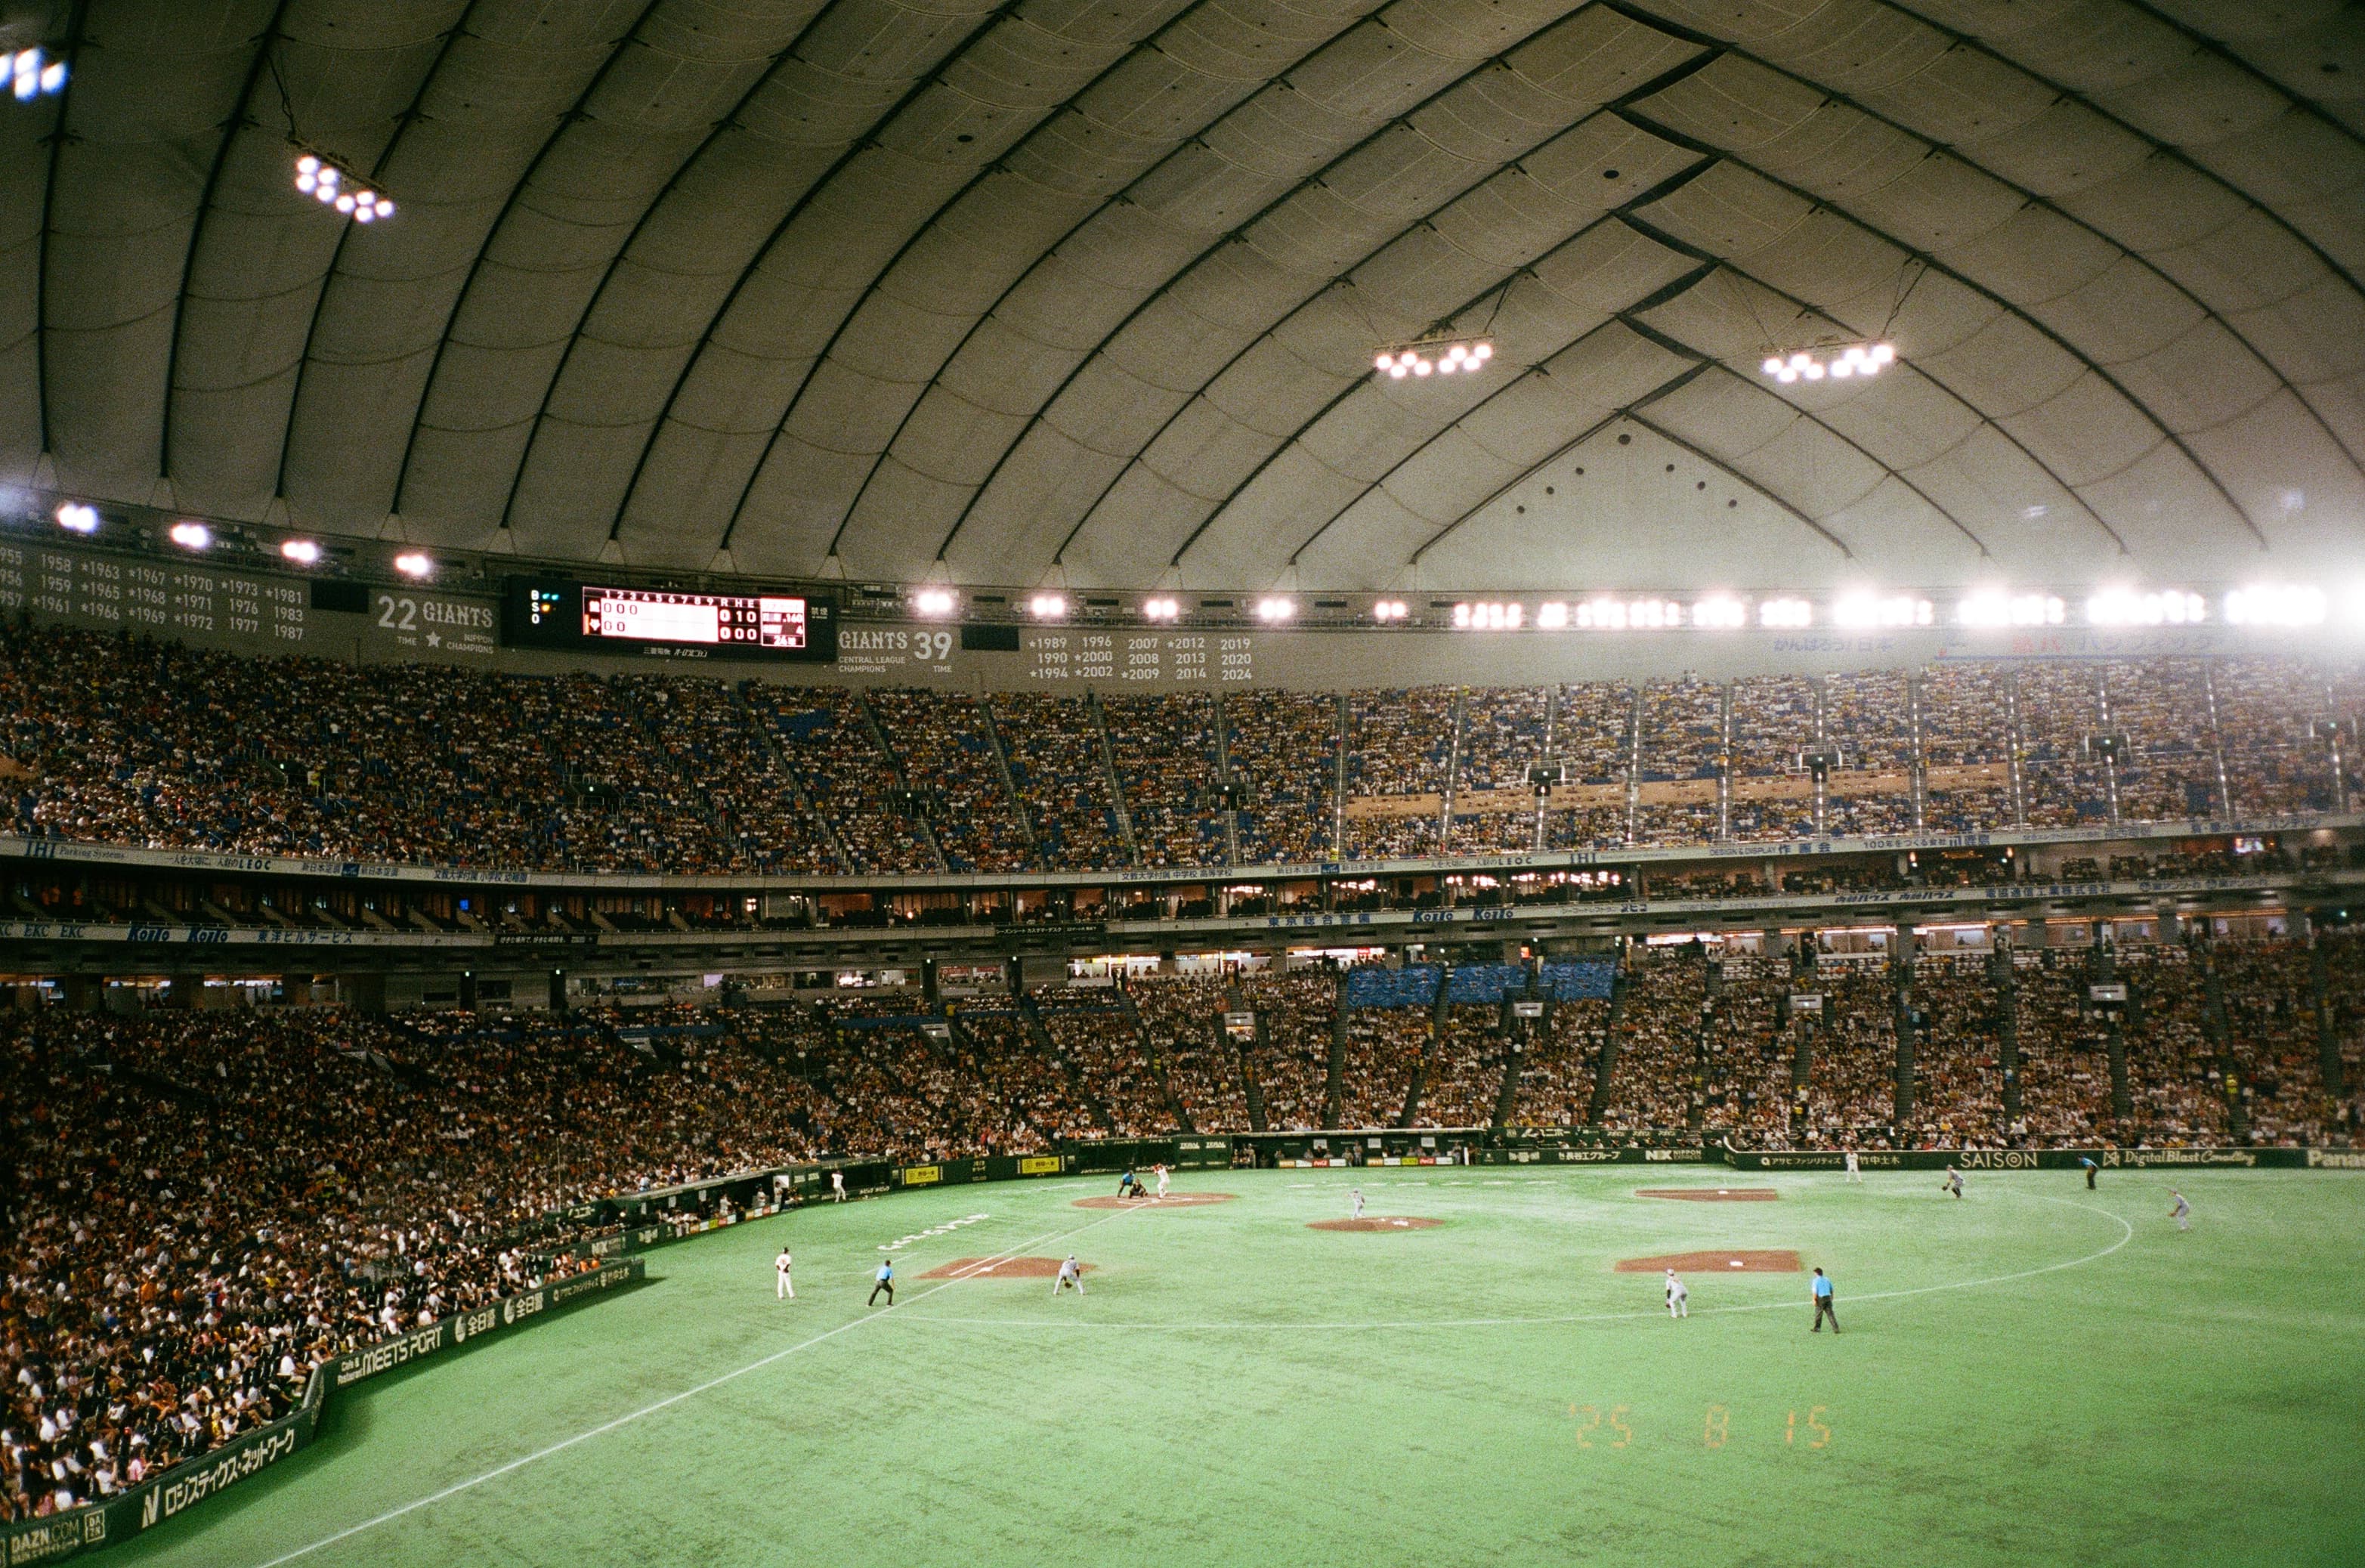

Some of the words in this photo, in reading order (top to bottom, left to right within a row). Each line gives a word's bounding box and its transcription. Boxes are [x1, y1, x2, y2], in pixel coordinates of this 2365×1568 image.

[42, 554, 71, 573] 1958
[90, 561, 119, 580] 1963
[138, 568, 165, 586] 1967
[184, 574, 212, 592] 1970
[230, 580, 258, 596] 1973
[274, 588, 301, 604] 1981
[42, 574, 71, 592] 1959
[90, 582, 119, 600] 1965
[138, 587, 165, 605] 1968
[184, 594, 212, 611] 1971
[230, 598, 258, 615] 1976
[274, 605, 303, 622] 1983
[531, 590, 539, 601] B
[605, 590, 611, 598] 1
[642, 593, 650, 602] 4
[656, 594, 663, 602] 5
[669, 595, 675, 603] 6
[682, 595, 688, 604] 7
[694, 597, 701, 605] 8
[707, 598, 714, 606] 9
[721, 598, 728, 607] R
[735, 599, 742, 608] H
[378, 595, 416, 631] 22
[422, 602, 493, 628] GIANTS
[531, 602, 539, 612] S
[604, 602, 611, 613] 0
[617, 603, 625, 614] 0
[629, 605, 637, 614] 0
[719, 609, 731, 622] 0
[736, 611, 743, 622] 1
[747, 611, 756, 623] 0
[42, 595, 70, 614] 1961
[90, 603, 119, 620] 1966
[138, 607, 165, 624] 1969
[184, 614, 212, 630] 1972
[230, 617, 258, 633] 1977
[274, 624, 303, 641] 1987
[604, 620, 612, 631] 0
[617, 621, 625, 632] 0
[720, 626, 731, 639] 0
[734, 628, 744, 640] 0
[747, 629, 756, 640] 0
[397, 636, 417, 646] TIME
[464, 634, 493, 644] NIPPON
[839, 630, 907, 649] GIANTS
[914, 631, 952, 660] 39
[1037, 637, 1067, 648] 1989
[1082, 636, 1111, 647] 1996
[1128, 638, 1158, 649] 2007
[1175, 637, 1204, 649] 2012
[1220, 638, 1251, 650] 2019
[447, 642, 493, 654] CHAMPIONS
[839, 656, 874, 664] CENTRAL
[876, 656, 905, 664] LEAGUE
[1037, 652, 1068, 663] 1990
[1082, 651, 1113, 663] 2000
[1129, 653, 1159, 665] 2008
[1175, 652, 1206, 664] 2013
[1221, 653, 1252, 666] 2020
[1038, 667, 1068, 679] 1994
[1083, 666, 1113, 678] 2002
[1129, 668, 1160, 680] 2009
[1176, 667, 1207, 679] 2014
[1222, 669, 1252, 680] 2024
[25, 841, 56, 859] IHI
[1710, 847, 1737, 855] DESIGN
[1745, 846, 1776, 855] DISPLAY
[1498, 857, 1532, 866] LEOC
[1570, 853, 1597, 864] IHI
[1860, 1155, 1900, 1165] 竹中土木
[1960, 1152, 2038, 1168] SAISON
[363, 1339, 408, 1376] MEETS
[410, 1326, 443, 1358] PORT
[165, 1427, 295, 1517] ロジスティクス・ネットワーク
